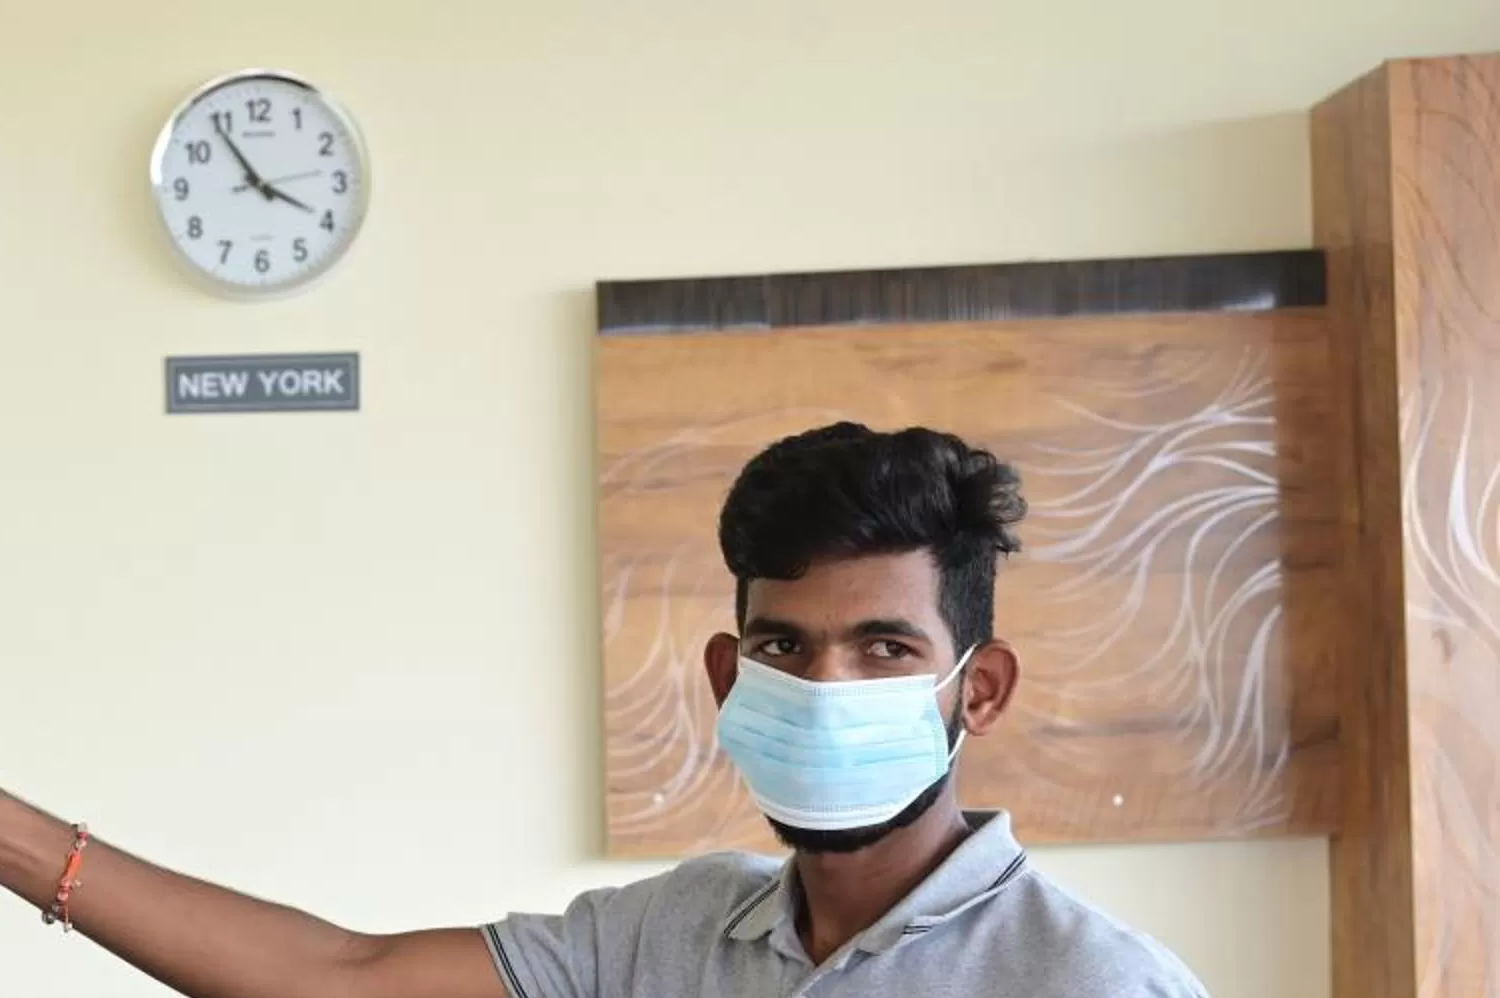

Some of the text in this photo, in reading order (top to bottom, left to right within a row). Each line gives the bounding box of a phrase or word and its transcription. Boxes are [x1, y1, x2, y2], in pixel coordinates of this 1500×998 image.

[210, 111, 233, 135] 11
[245, 98, 272, 123] 12
[291, 107, 302, 130] 1
[184, 140, 212, 165] 10
[318, 131, 334, 157] 2
[172, 177, 190, 202] 9
[332, 170, 348, 195] 3
[186, 215, 204, 240] 8
[319, 209, 335, 233] 4
[217, 239, 234, 265] 7
[253, 249, 271, 273] 6
[292, 237, 309, 263] 5
[178, 368, 345, 399] NEW YORK
